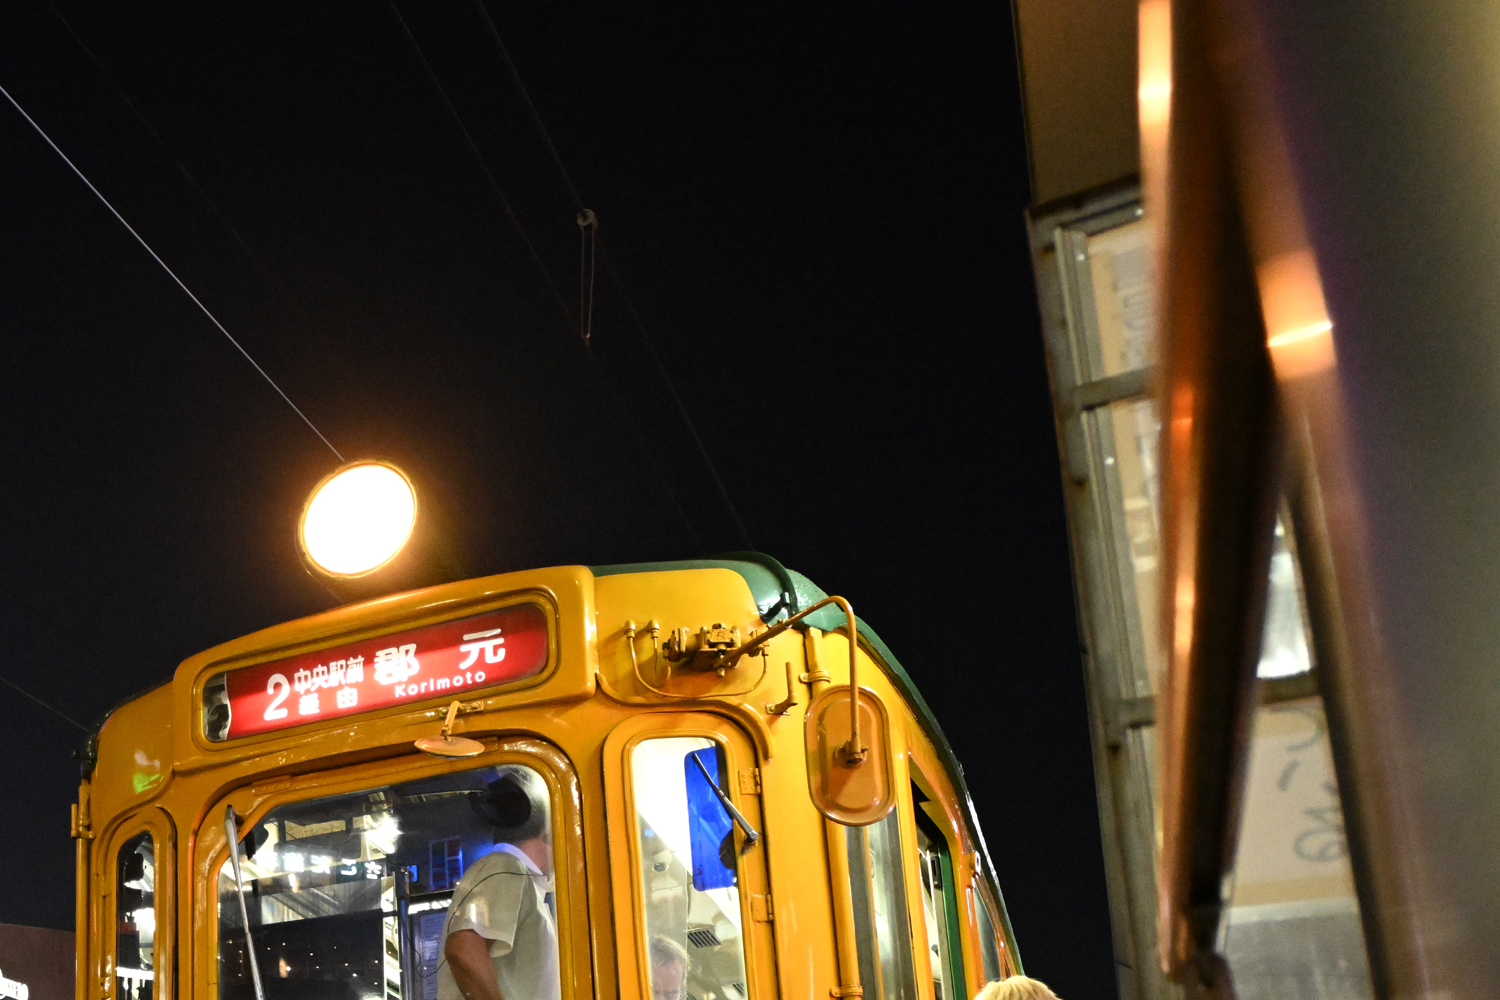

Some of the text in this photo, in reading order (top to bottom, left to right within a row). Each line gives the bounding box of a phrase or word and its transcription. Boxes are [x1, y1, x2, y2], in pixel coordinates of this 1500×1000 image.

[294, 655, 364, 694] 中央駅前
[374, 628, 506, 686] 郡元
[264, 673, 290, 721] 2
[395, 669, 486, 698] Korimoto
